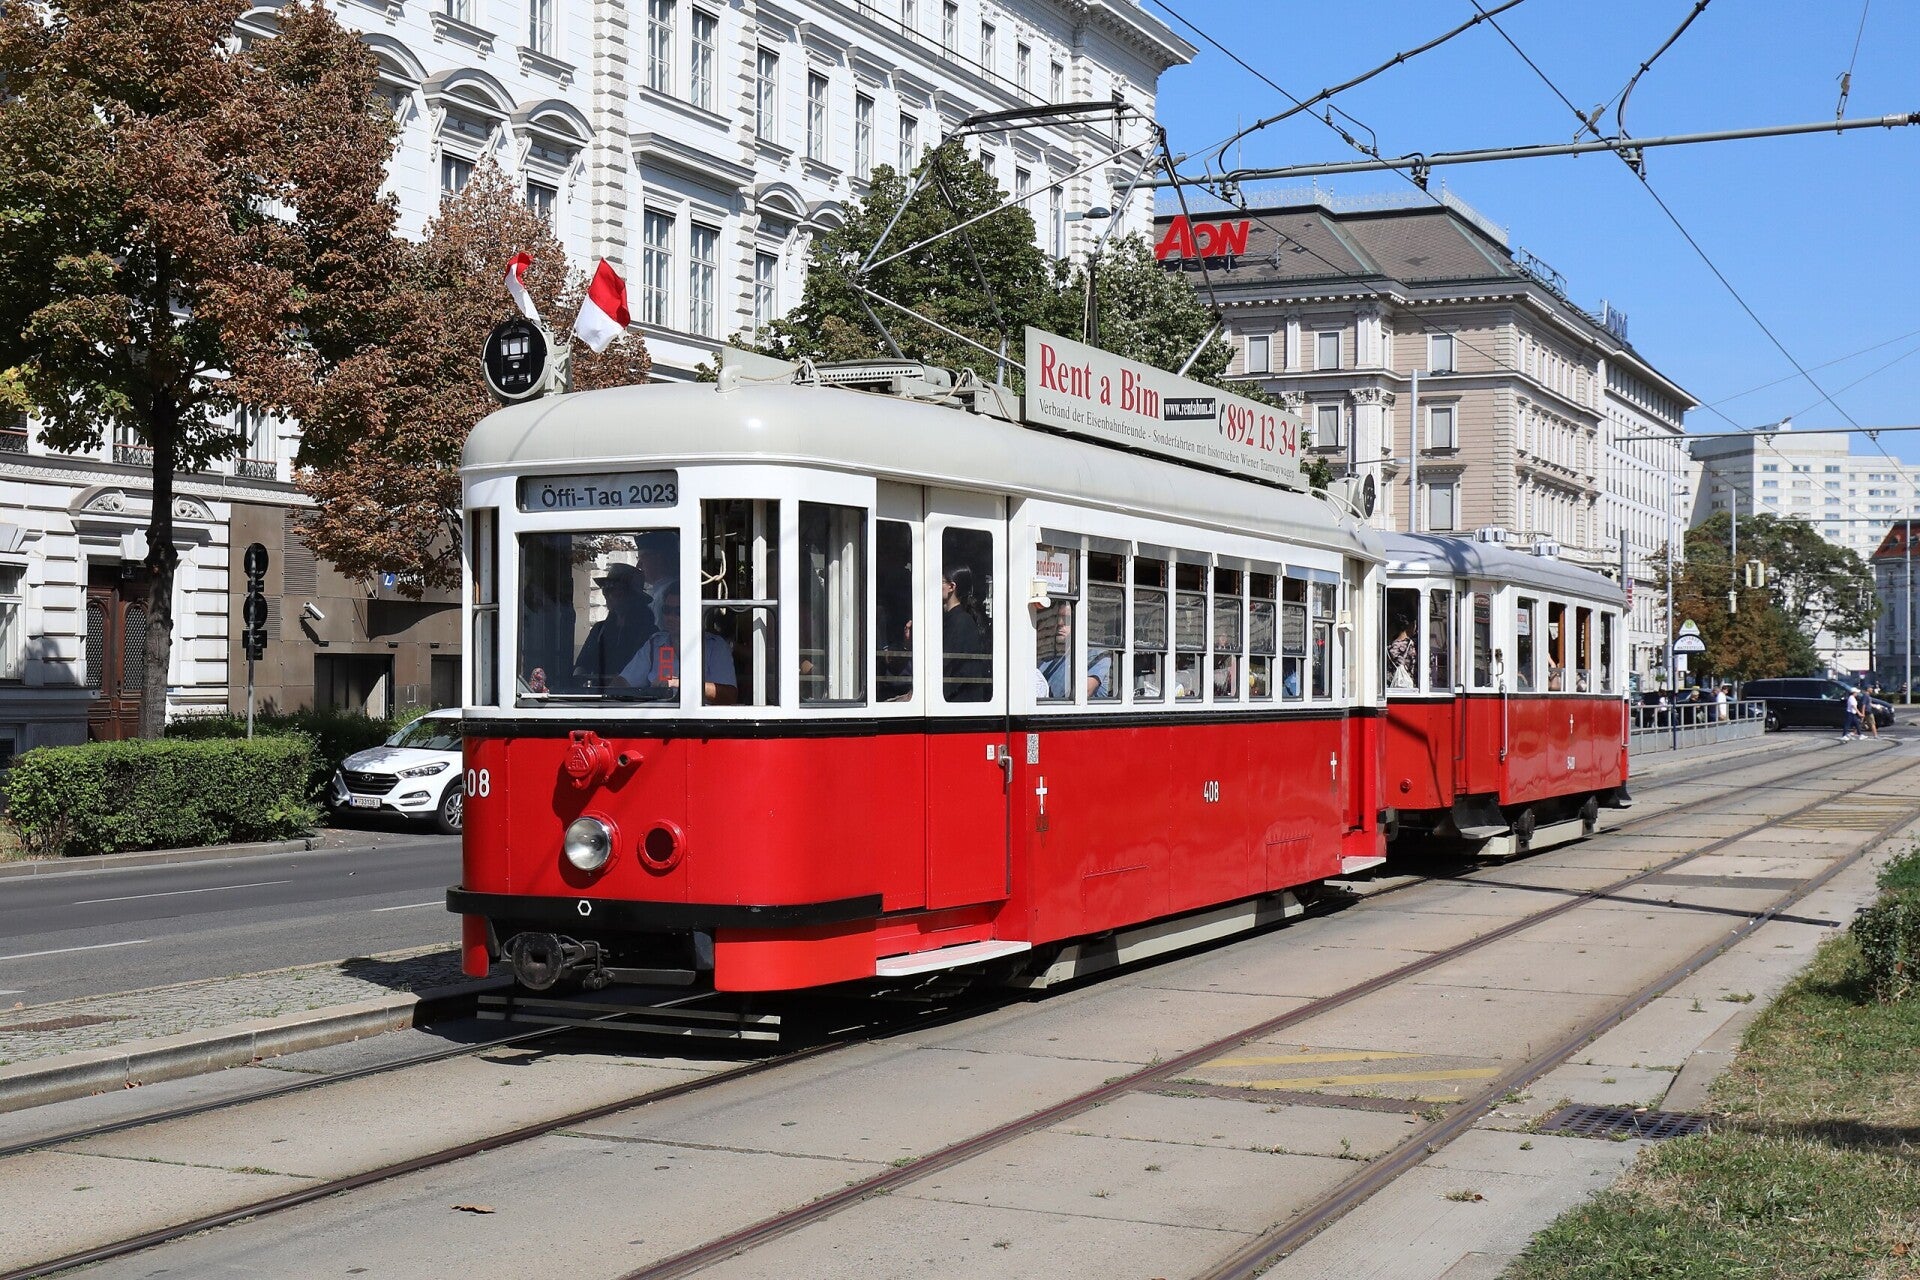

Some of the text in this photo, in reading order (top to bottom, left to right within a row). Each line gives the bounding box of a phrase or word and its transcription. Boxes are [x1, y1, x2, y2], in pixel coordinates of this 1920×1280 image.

[1154, 215, 1250, 260] AON
[1039, 342, 1159, 419] Rent a Bim
[1164, 399, 1215, 416] www.rentabim.at
[1039, 398, 1070, 420] Verband
[1072, 408, 1085, 424] der
[1086, 411, 1147, 440] Eisenbahnfreunde
[1153, 429, 1195, 453] Sonderfahrten
[1196, 442, 1207, 456] mit
[1207, 443, 1240, 464] historischen
[1240, 452, 1260, 470] Wiener
[1227, 403, 1297, 458] 892 13 34
[541, 483, 678, 507] Öffi-Tag 2023
[1203, 780, 1219, 802] 408
